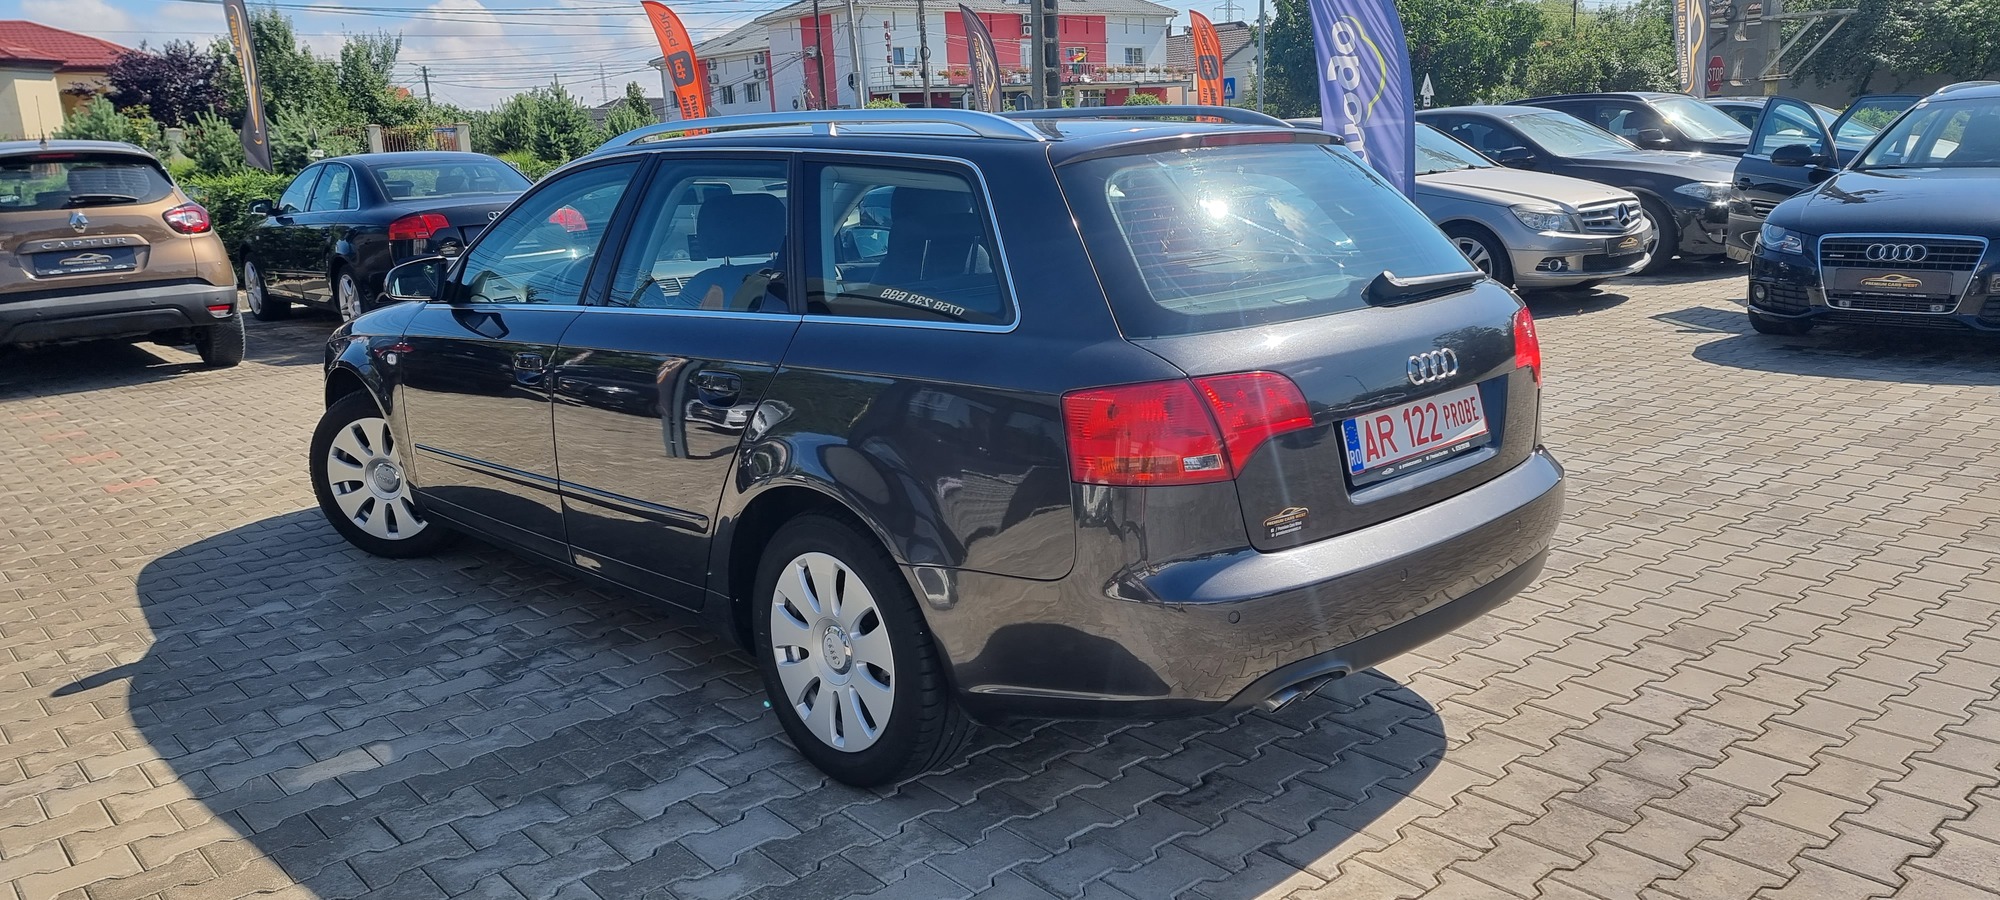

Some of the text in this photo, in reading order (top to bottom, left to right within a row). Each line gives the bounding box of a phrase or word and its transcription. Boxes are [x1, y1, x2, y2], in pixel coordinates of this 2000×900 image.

[883, 20, 894, 75] HOTEL
[1708, 67, 1724, 82] STOP
[41, 237, 127, 250] CAPTUR
[1365, 396, 1480, 463] AR 122 PROBE
[1350, 449, 1362, 467] RO
